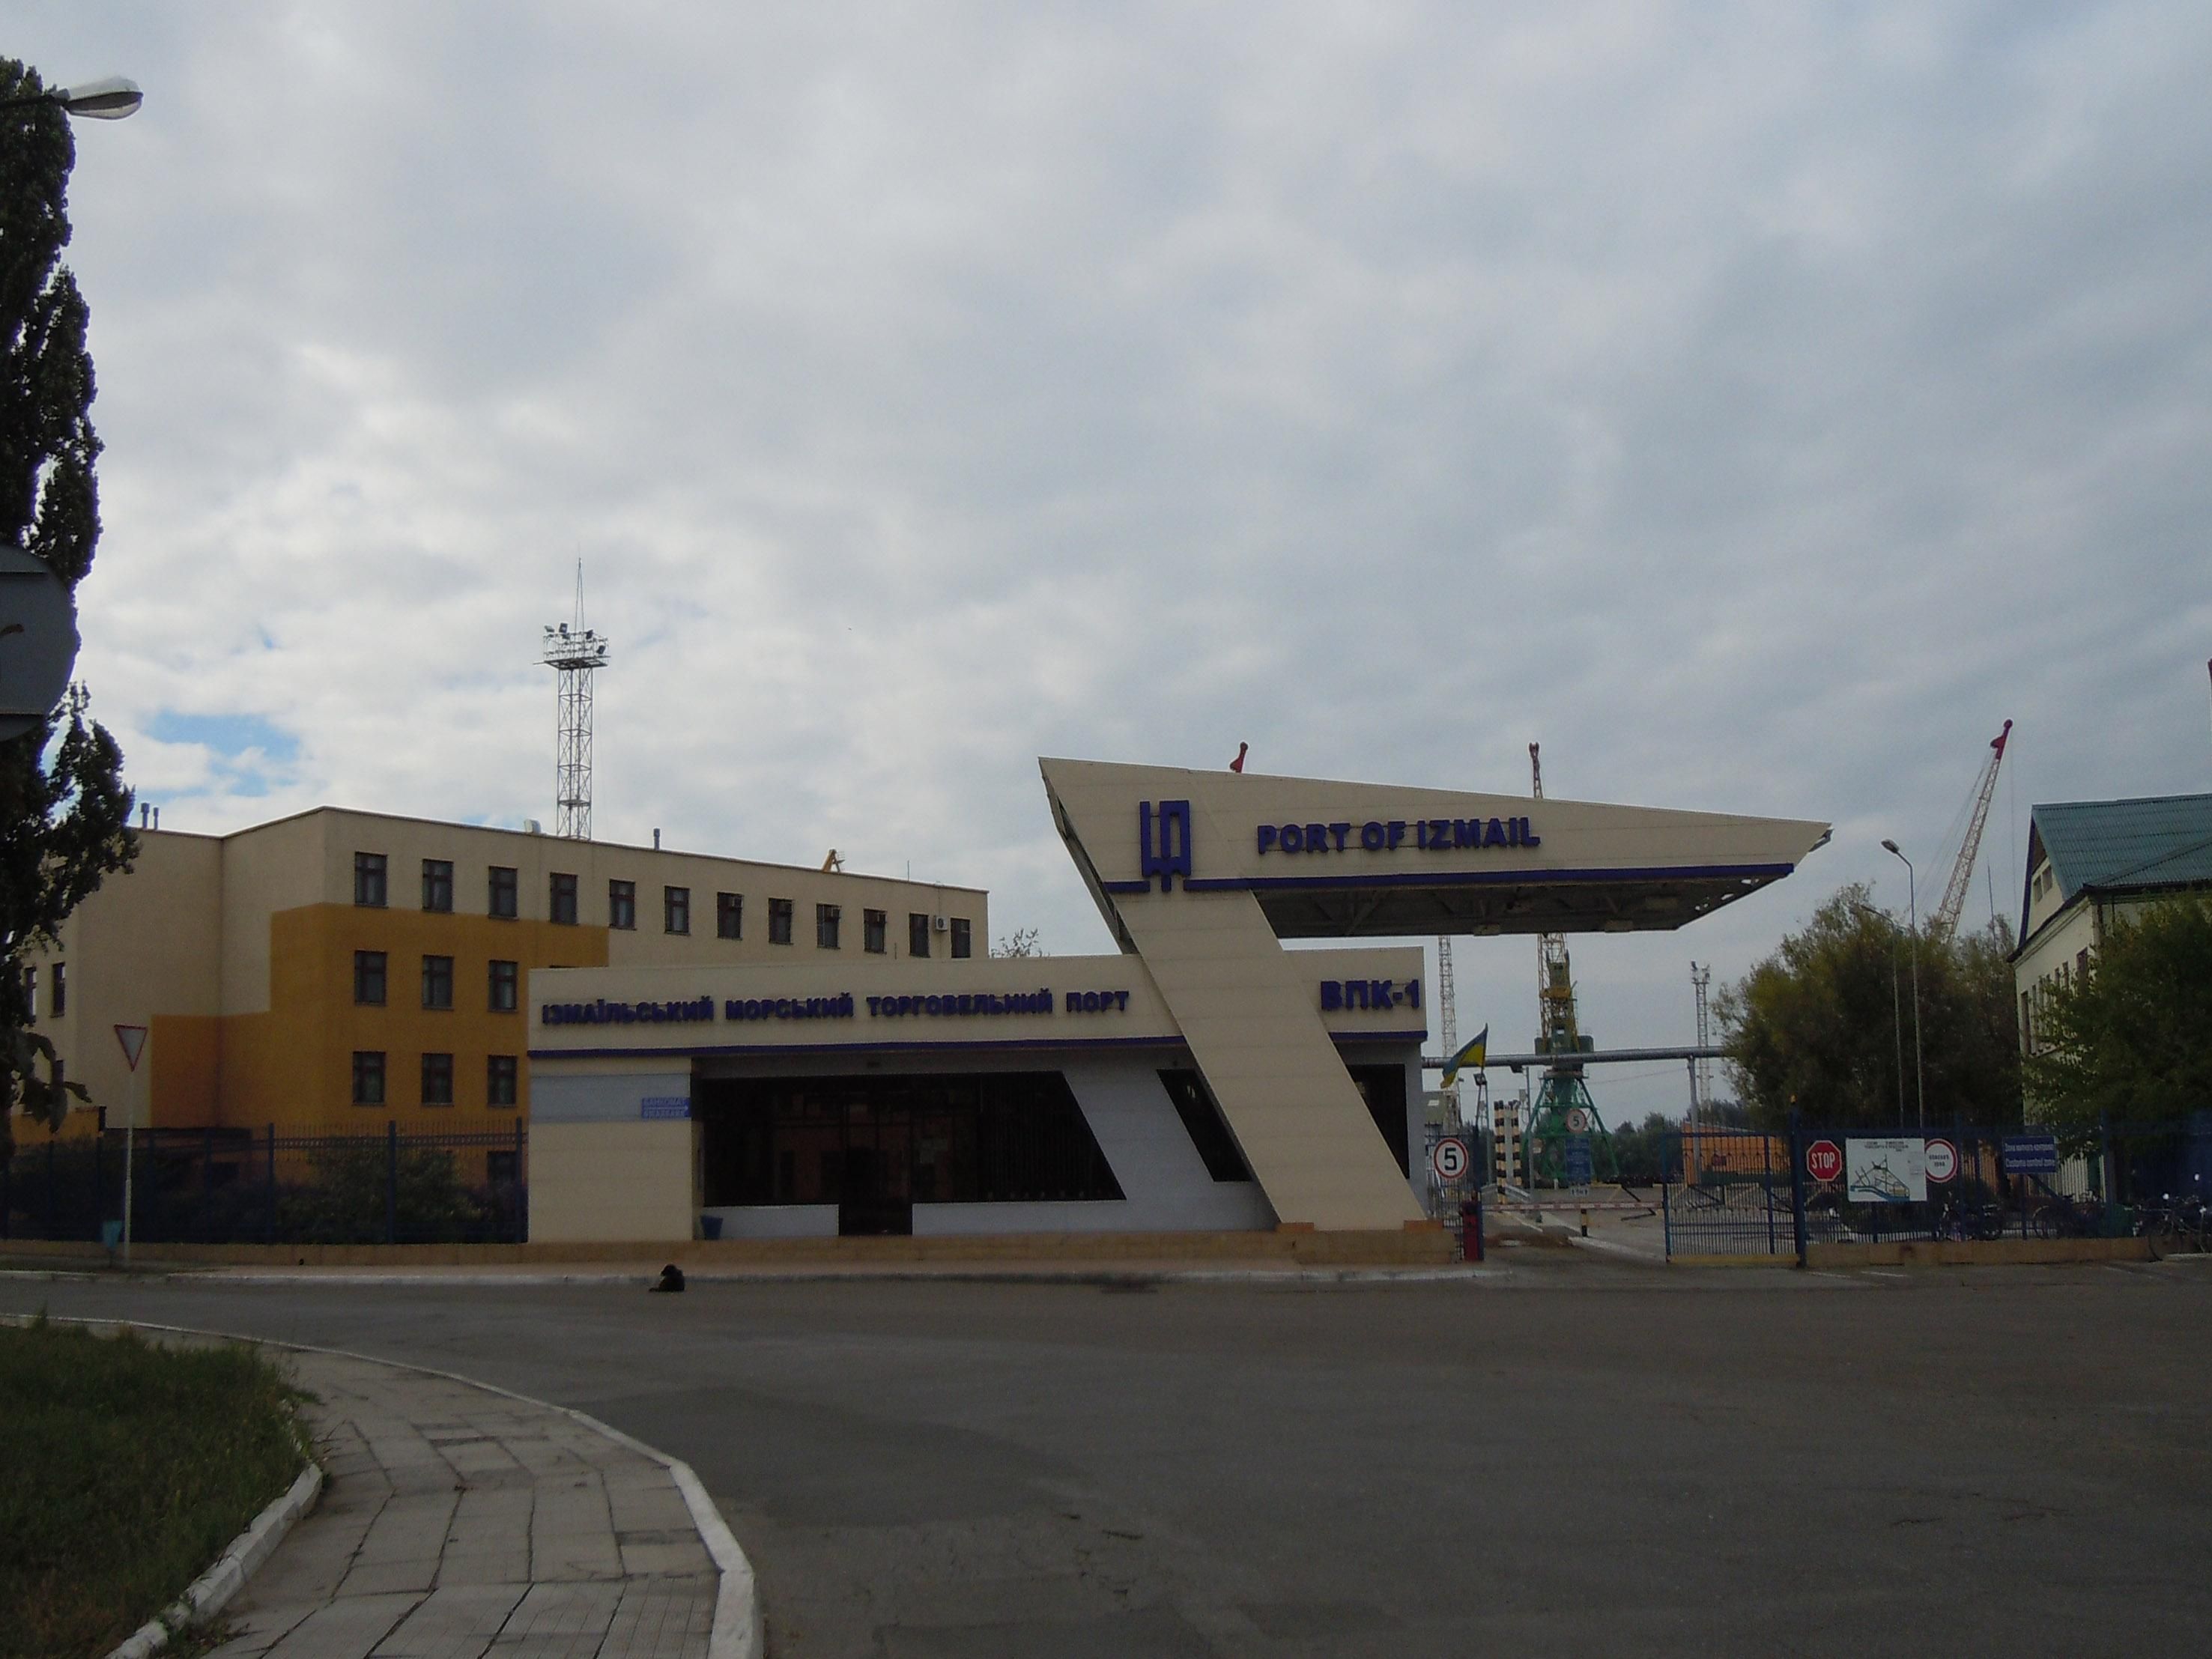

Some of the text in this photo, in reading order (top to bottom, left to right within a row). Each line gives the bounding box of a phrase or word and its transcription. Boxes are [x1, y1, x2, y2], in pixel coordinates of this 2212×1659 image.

[1257, 816, 1541, 855] PORT OF IZMAIL
[726, 992, 854, 1020] МОРСЬКИЙ
[866, 987, 1053, 1016] ТОРГОВЕЛЬНИЙ
[1066, 990, 1130, 1013] ПОРТ
[1321, 978, 1419, 1010] ВПК-1
[1572, 1115, 1580, 1126] 5
[1443, 1147, 1457, 1171] 5
[1811, 1152, 1835, 1169] STOP
